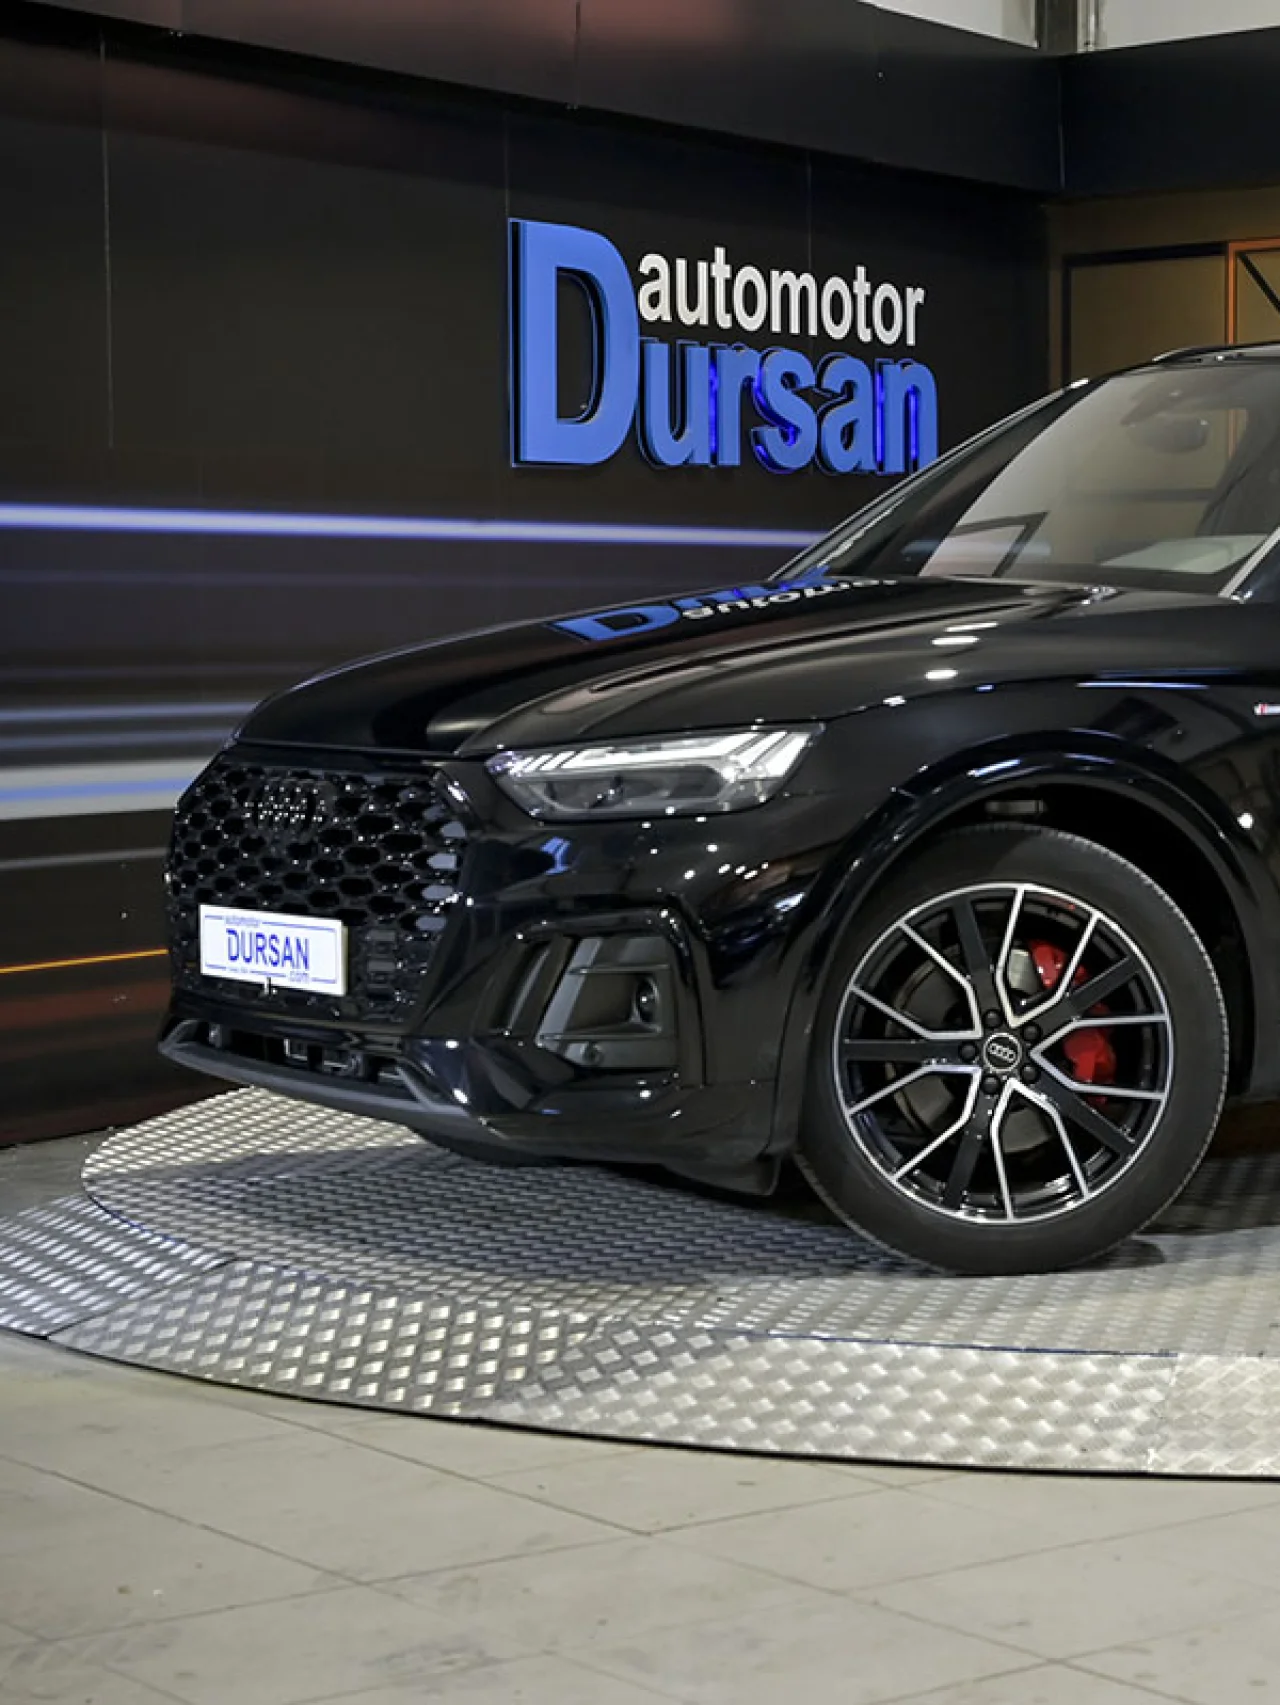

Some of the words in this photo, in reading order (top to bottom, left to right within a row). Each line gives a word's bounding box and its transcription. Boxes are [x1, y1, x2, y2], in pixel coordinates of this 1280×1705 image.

[637, 246, 925, 346] automotor
[508, 217, 938, 478] Dursan
[226, 928, 310, 970] DURSAN
